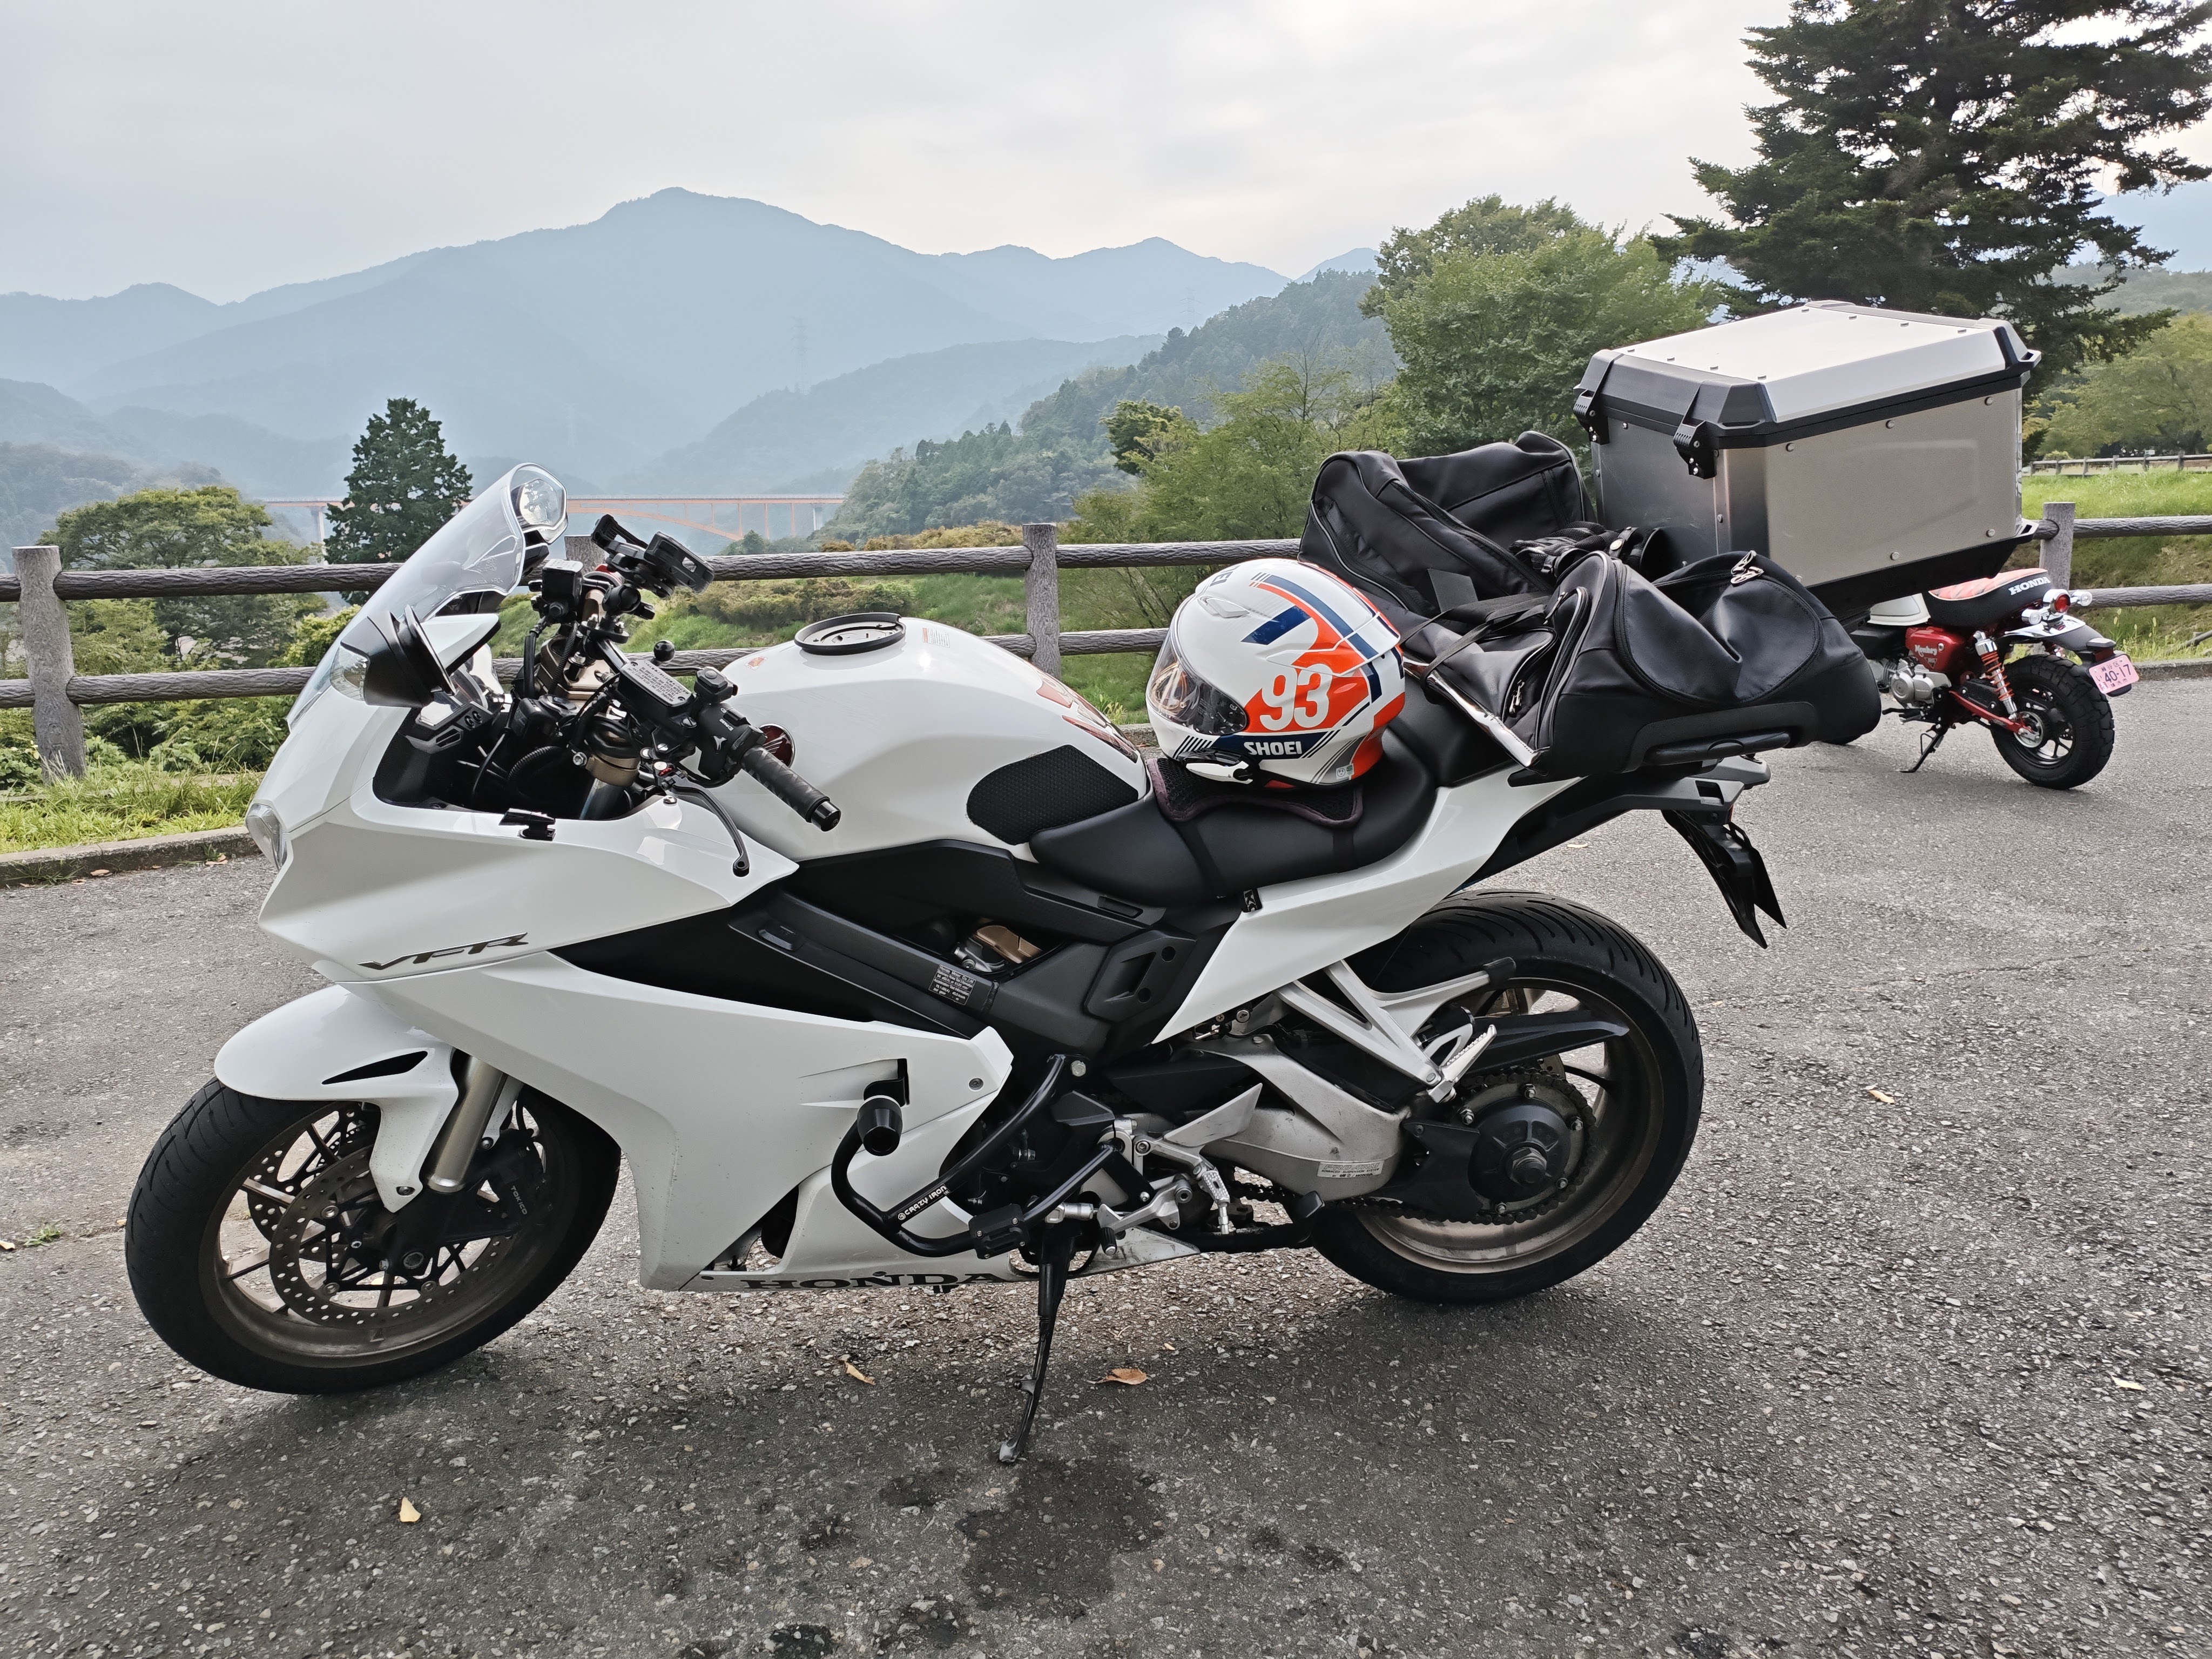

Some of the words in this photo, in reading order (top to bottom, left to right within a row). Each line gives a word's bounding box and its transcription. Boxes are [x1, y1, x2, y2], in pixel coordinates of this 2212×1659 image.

[2008, 577, 2051, 596] HONDA
[1914, 644, 1938, 657] Monkey
[2105, 664, 2132, 683] 40-17
[1260, 663, 1332, 731] 93
[1244, 741, 1303, 756] SHOEI
[357, 932, 529, 970] VFR
[510, 1184, 528, 1215] TOKICO
[905, 1198, 928, 1215] CRAZY
[740, 1273, 1007, 1290] HONDA
